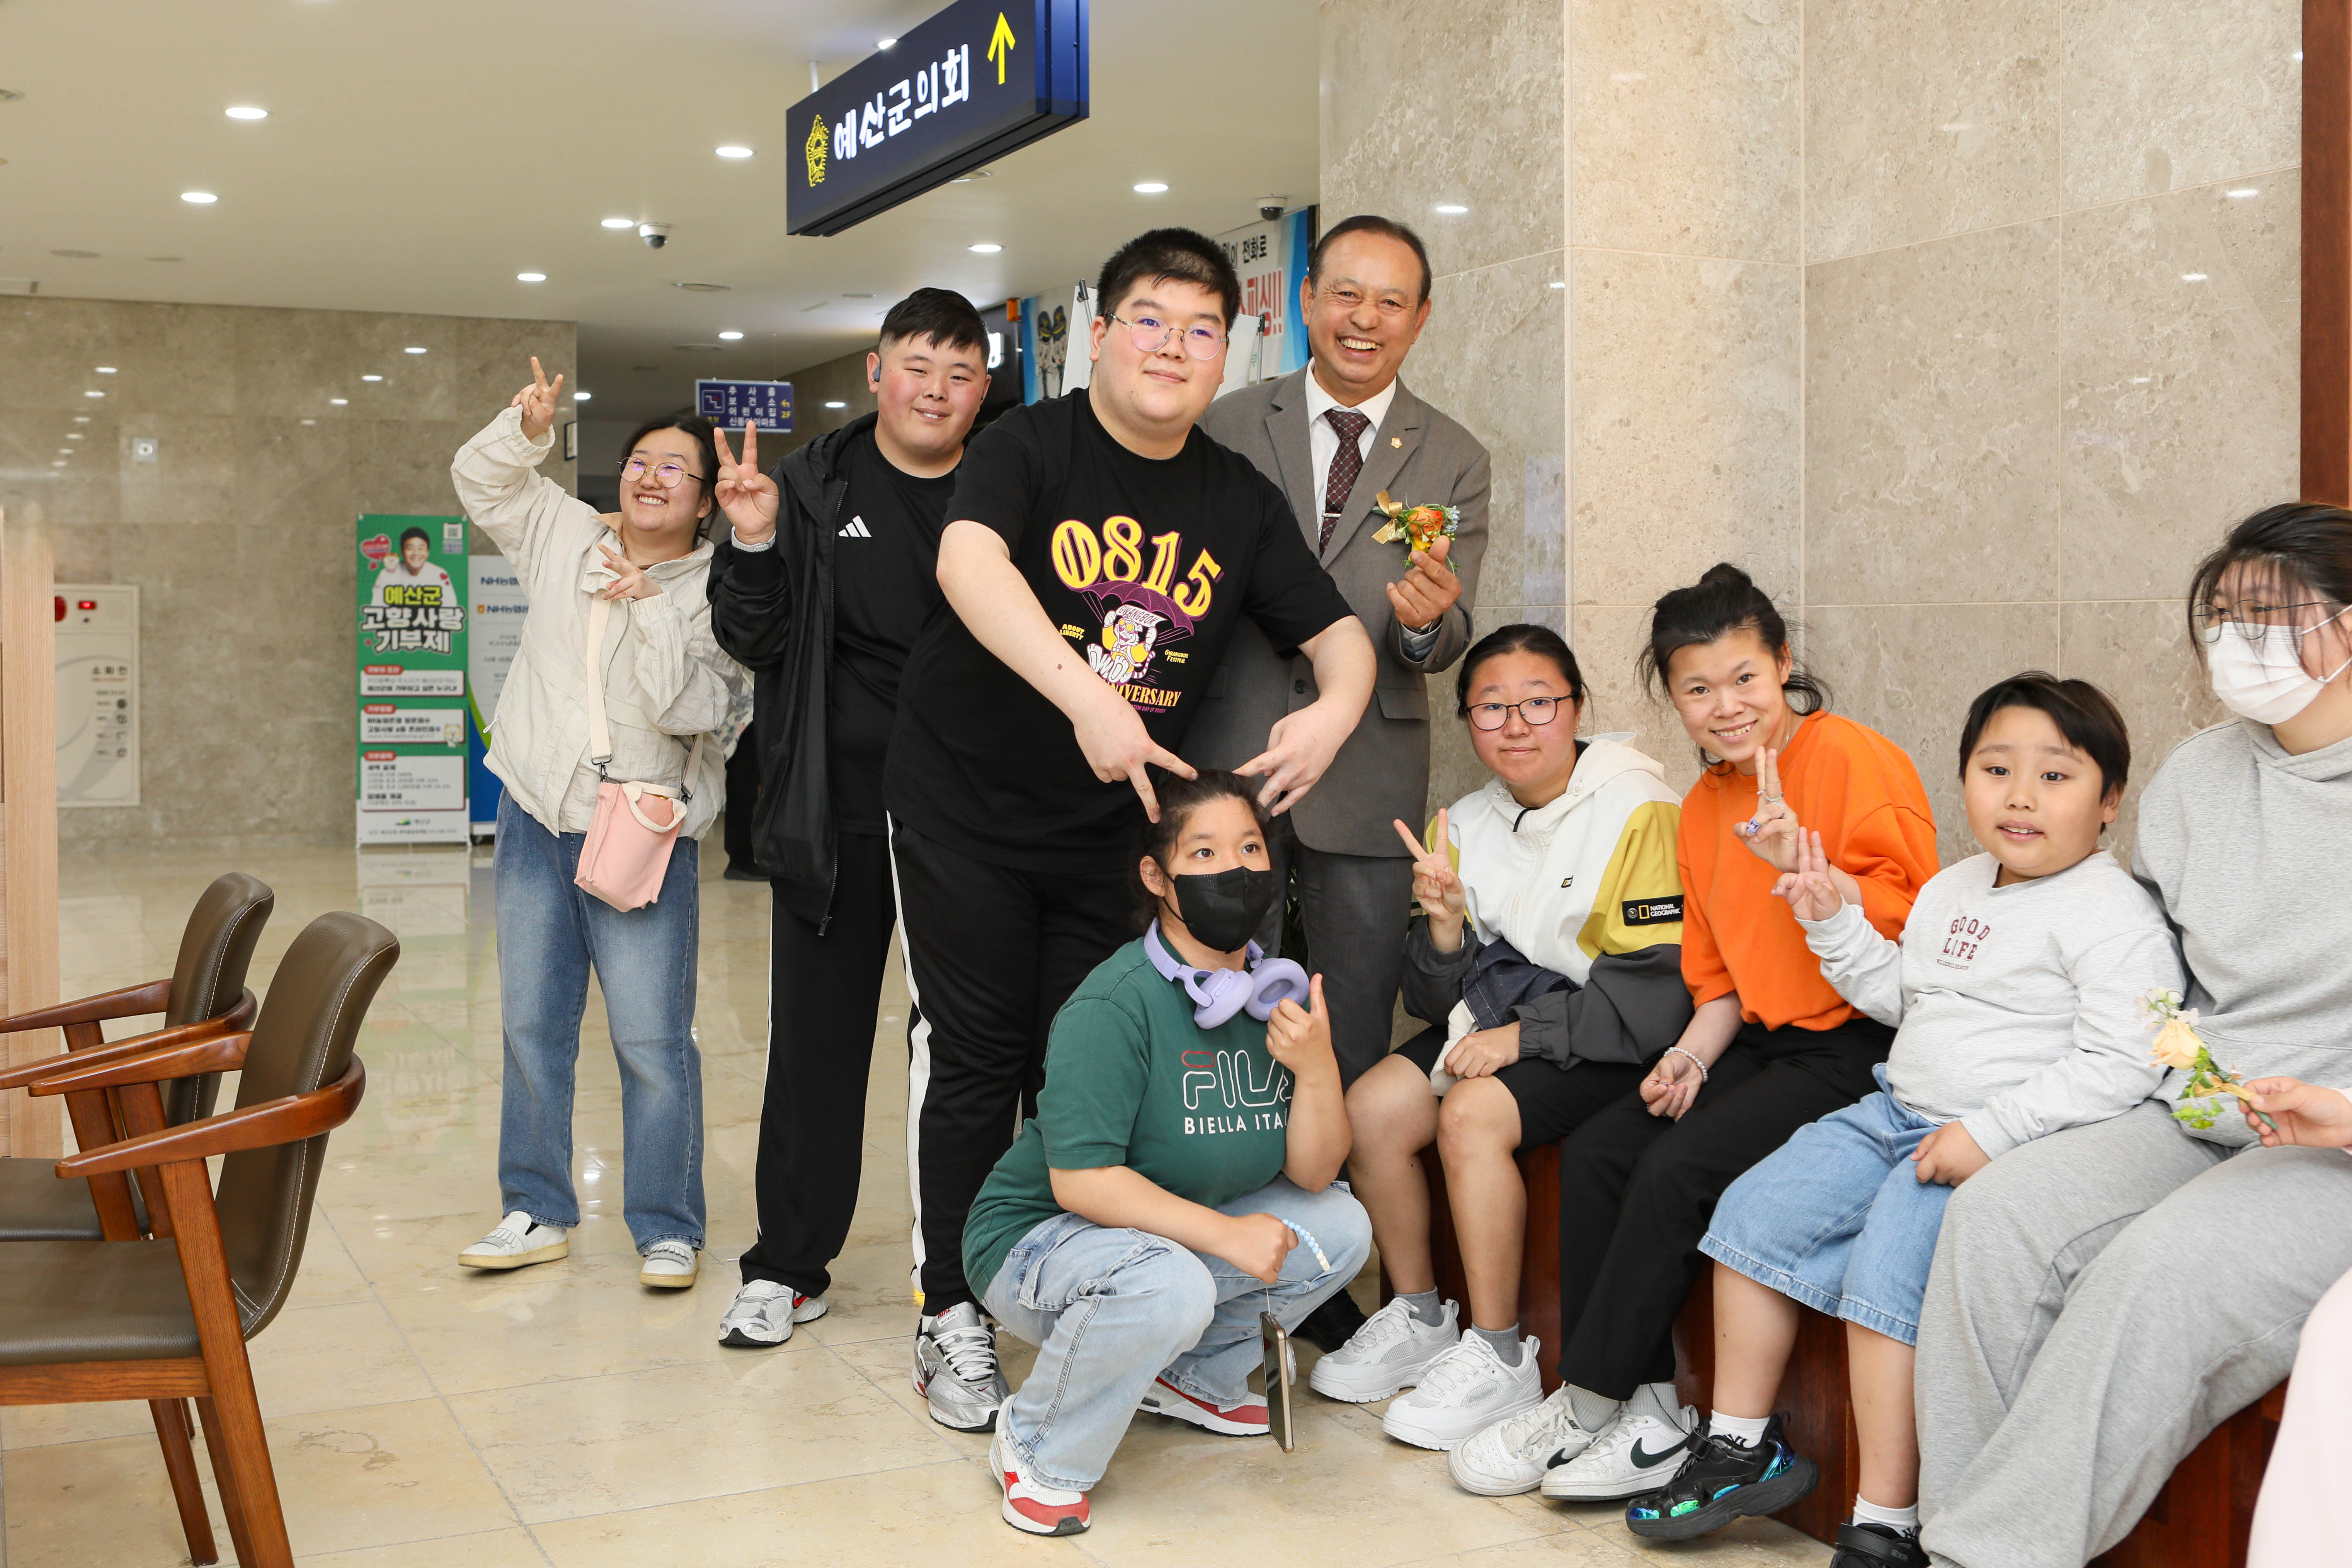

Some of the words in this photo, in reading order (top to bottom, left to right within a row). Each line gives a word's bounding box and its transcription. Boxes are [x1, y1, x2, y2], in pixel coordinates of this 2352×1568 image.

[834, 43, 969, 160] 예산군의회
[1243, 235, 1267, 264] 전화로
[1051, 515, 1223, 619] 0815
[481, 577, 520, 585] NH농협
[385, 586, 442, 605] 예산군
[361, 607, 464, 631] 고향사랑
[1119, 605, 1157, 625] GWANGBOK
[1060, 629, 1084, 640] LIBERTY
[1062, 624, 1085, 634] ABOUT
[375, 629, 451, 653] 기부제
[1650, 908, 1681, 917] GEOGRAPHIC
[1950, 916, 1991, 941] GOOD
[1942, 937, 1978, 961] LIFE
[1185, 1114, 1247, 1134] BIELLA
[941, 1313, 956, 1324] INITIATOR
